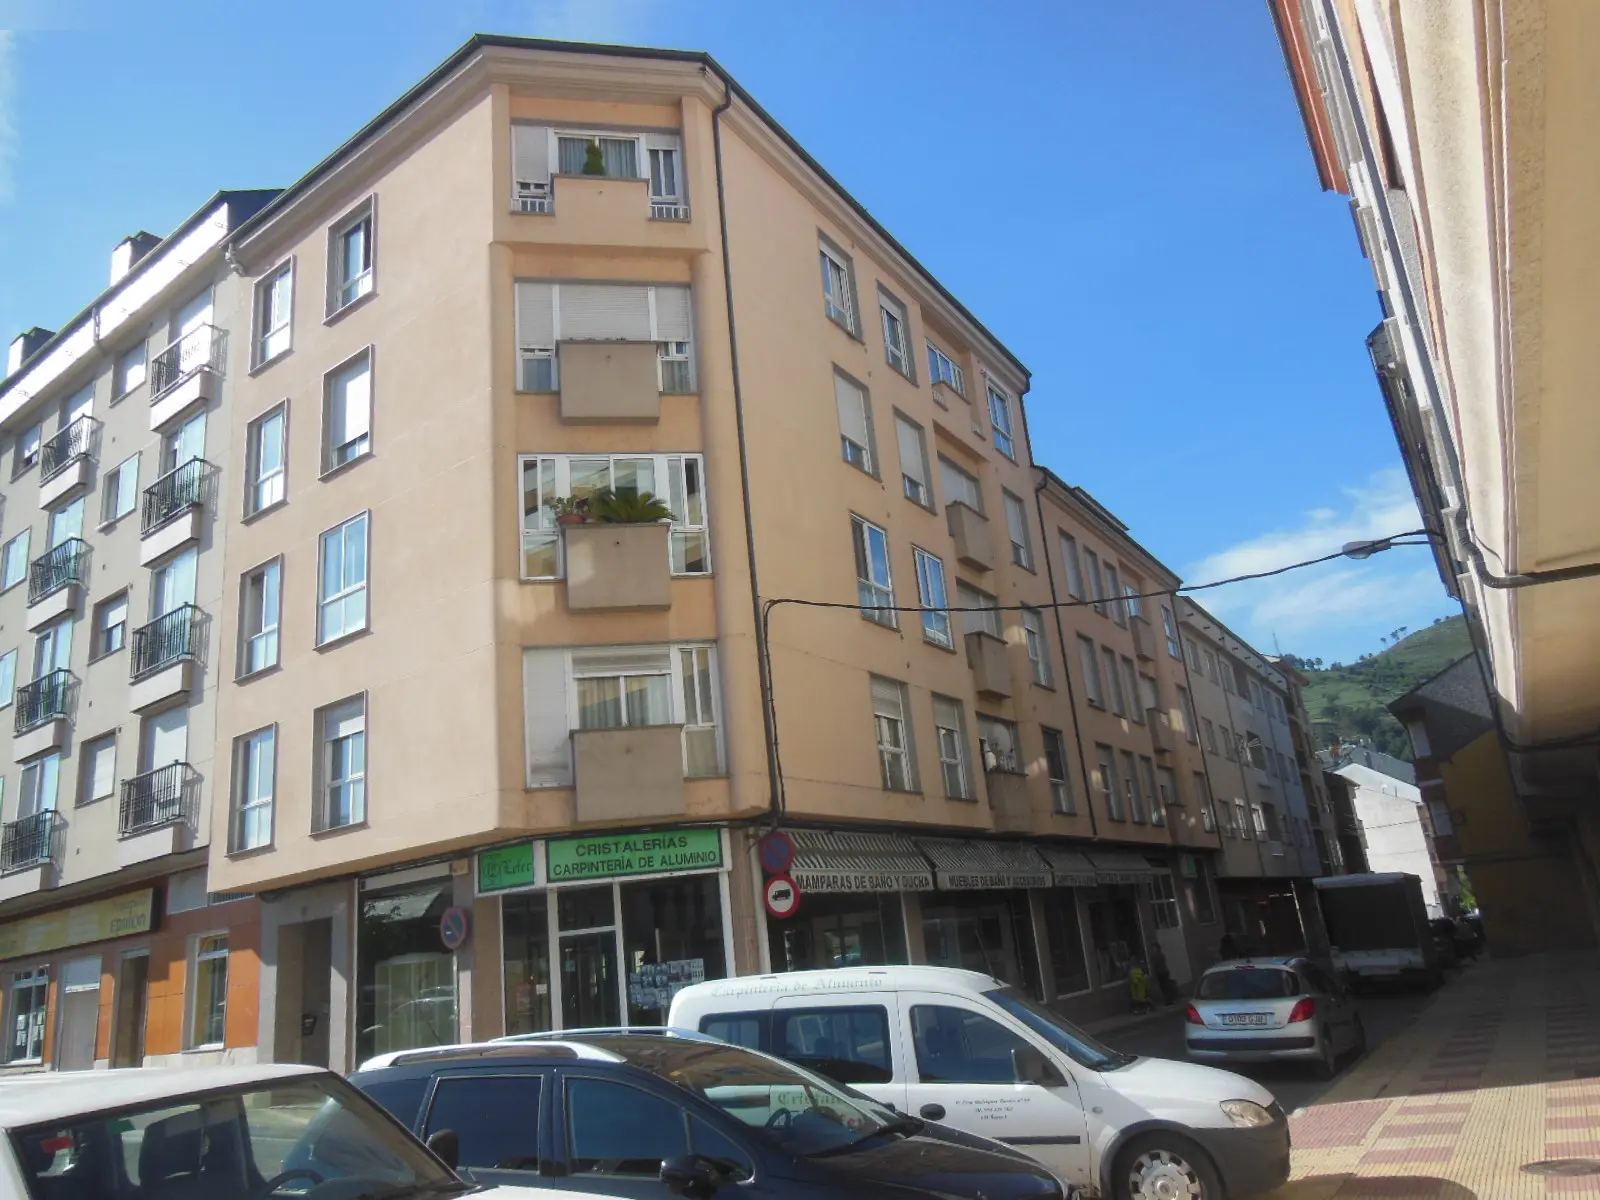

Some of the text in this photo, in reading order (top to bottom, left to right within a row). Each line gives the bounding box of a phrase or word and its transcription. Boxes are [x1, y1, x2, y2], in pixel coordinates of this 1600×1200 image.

[575, 836, 688, 857] CRISTALERÍAS
[553, 850, 717, 876] CARPINTERÍA DE ALUMINIO
[796, 874, 852, 890] MAMPARAS
[854, 875, 868, 889] DE
[902, 875, 930, 888] DUCHA
